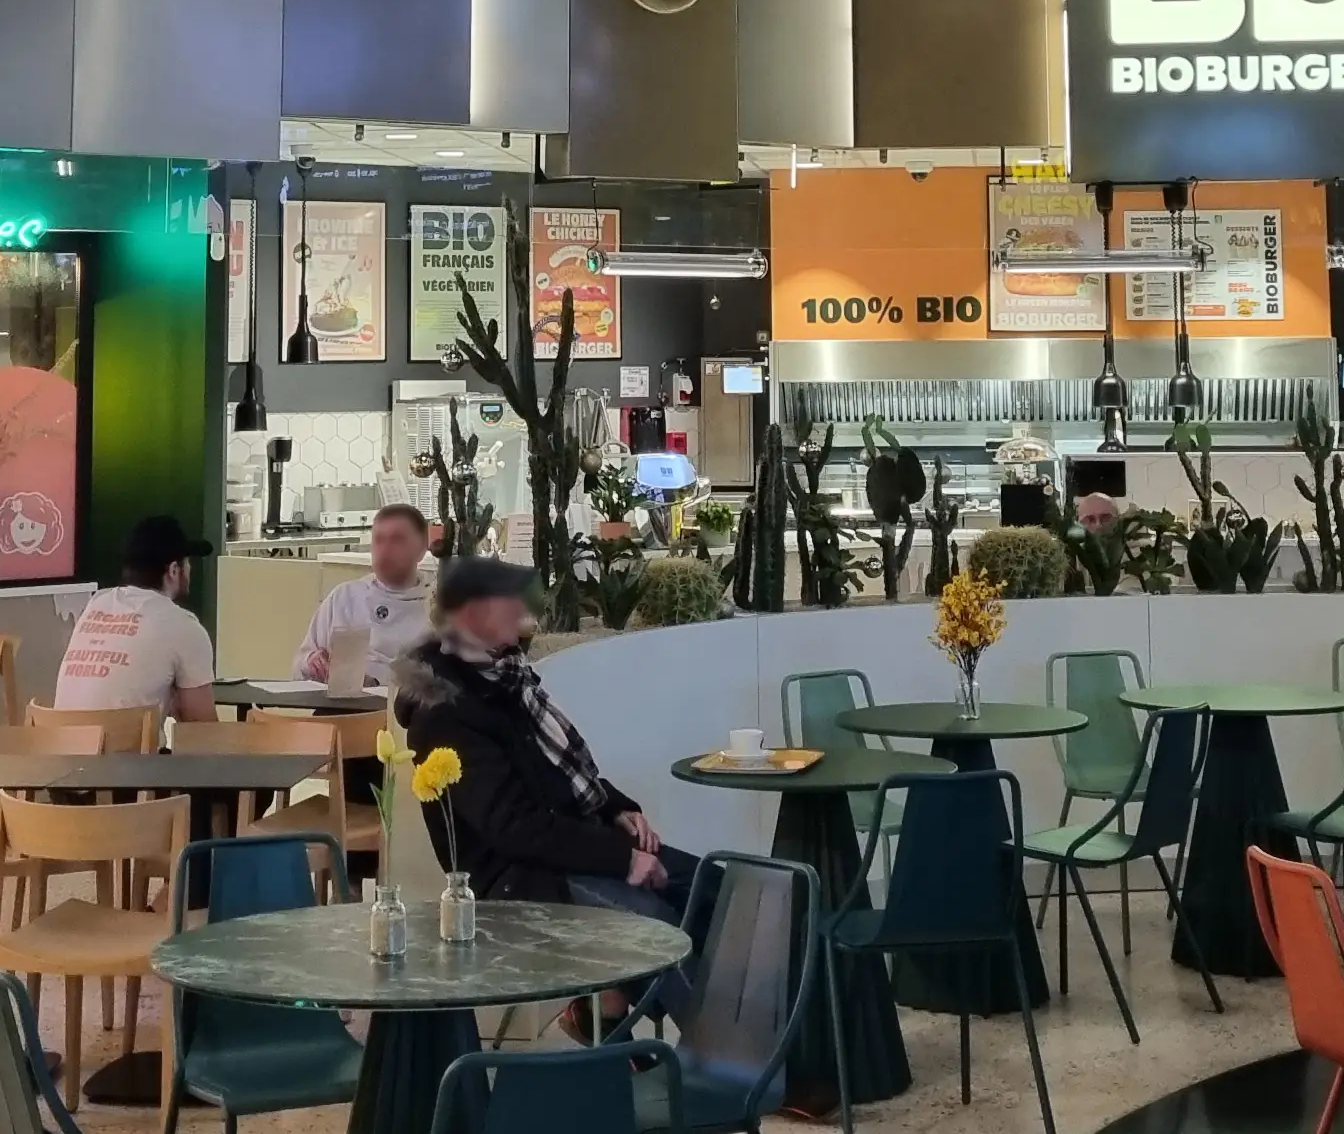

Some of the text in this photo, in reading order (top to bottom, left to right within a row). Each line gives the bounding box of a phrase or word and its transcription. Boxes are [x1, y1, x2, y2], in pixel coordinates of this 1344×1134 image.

[544, 212, 605, 227] LE HONEY
[422, 212, 495, 251] BIO
[547, 227, 602, 240] CHICKEN
[330, 235, 359, 251] ICE
[422, 254, 495, 272] FRANÇAIS
[1264, 215, 1279, 314] BIOBURGER
[422, 279, 495, 292] VÉGÉTRIEN
[801, 296, 982, 324] 100% BIO
[998, 312, 1098, 327] BIOBURGER
